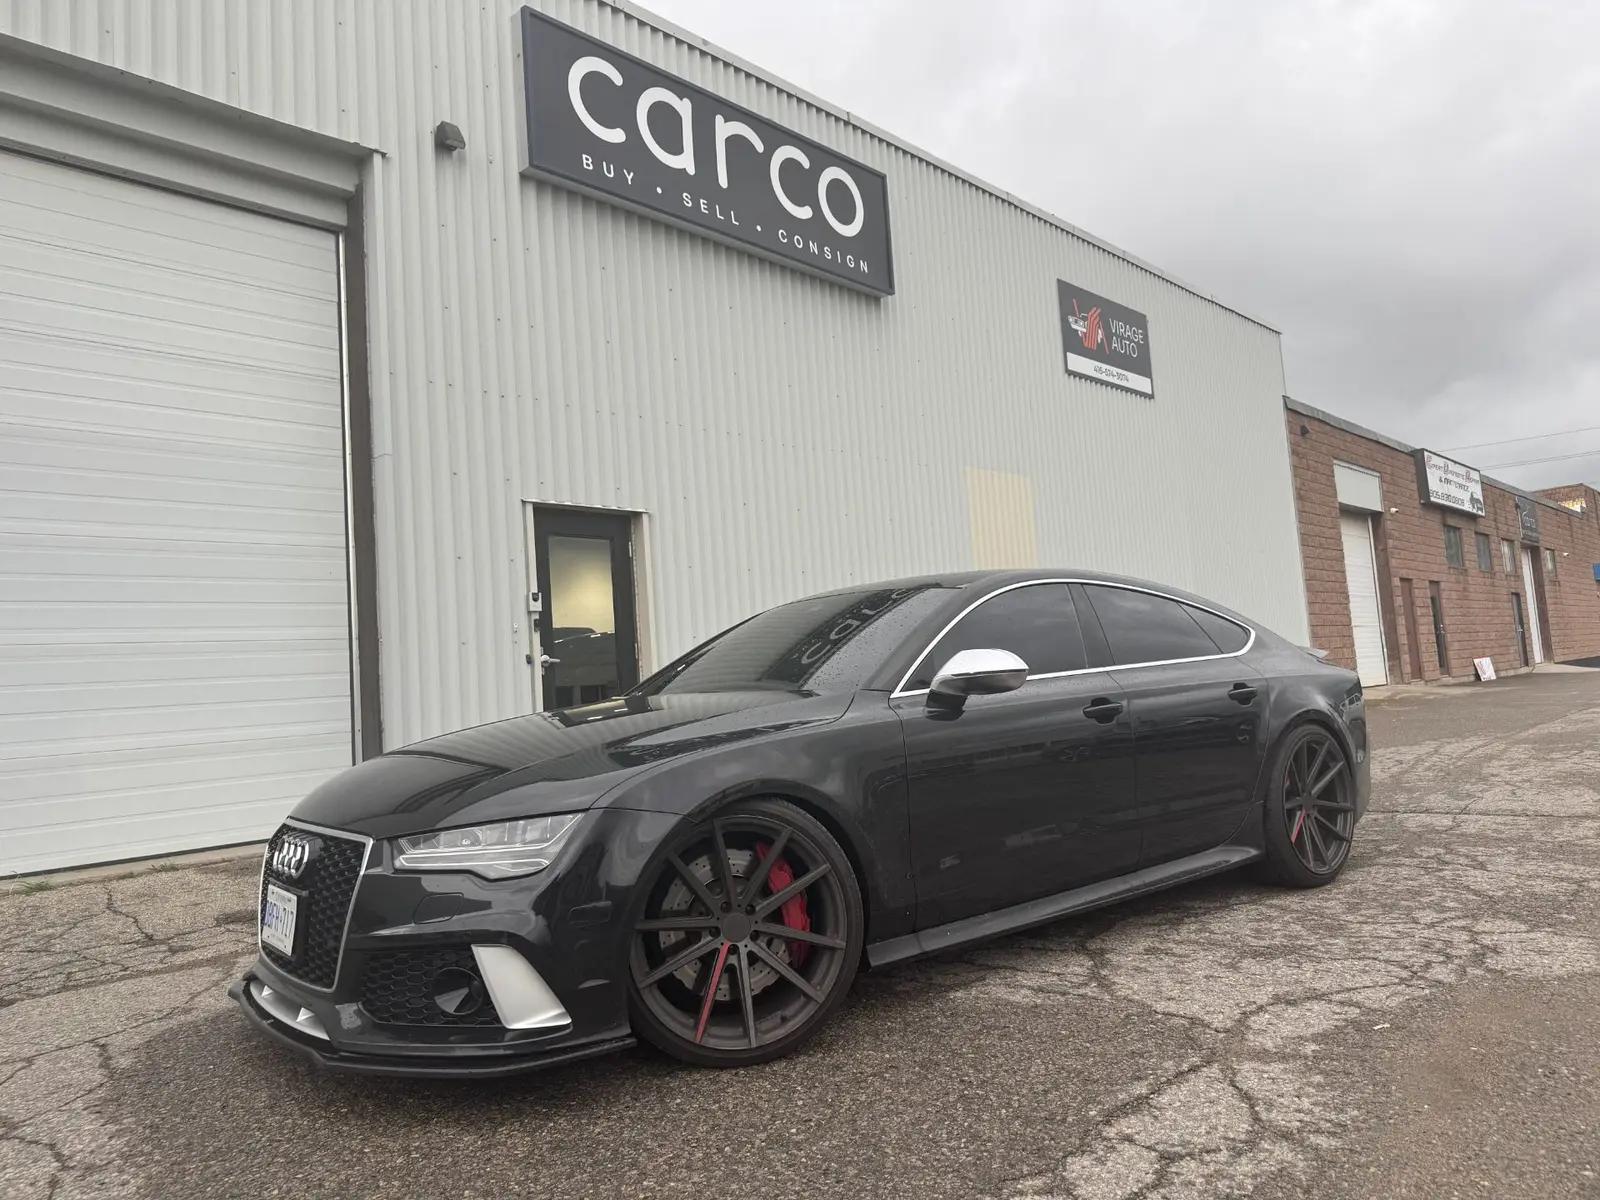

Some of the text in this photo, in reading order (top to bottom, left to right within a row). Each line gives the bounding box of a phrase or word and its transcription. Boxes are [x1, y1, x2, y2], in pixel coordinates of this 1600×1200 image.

[567, 56, 865, 238] carco
[581, 153, 869, 274] BUY SELL CONSIGN
[1109, 318, 1144, 344] VIRAGE
[1111, 336, 1138, 358] AUTO
